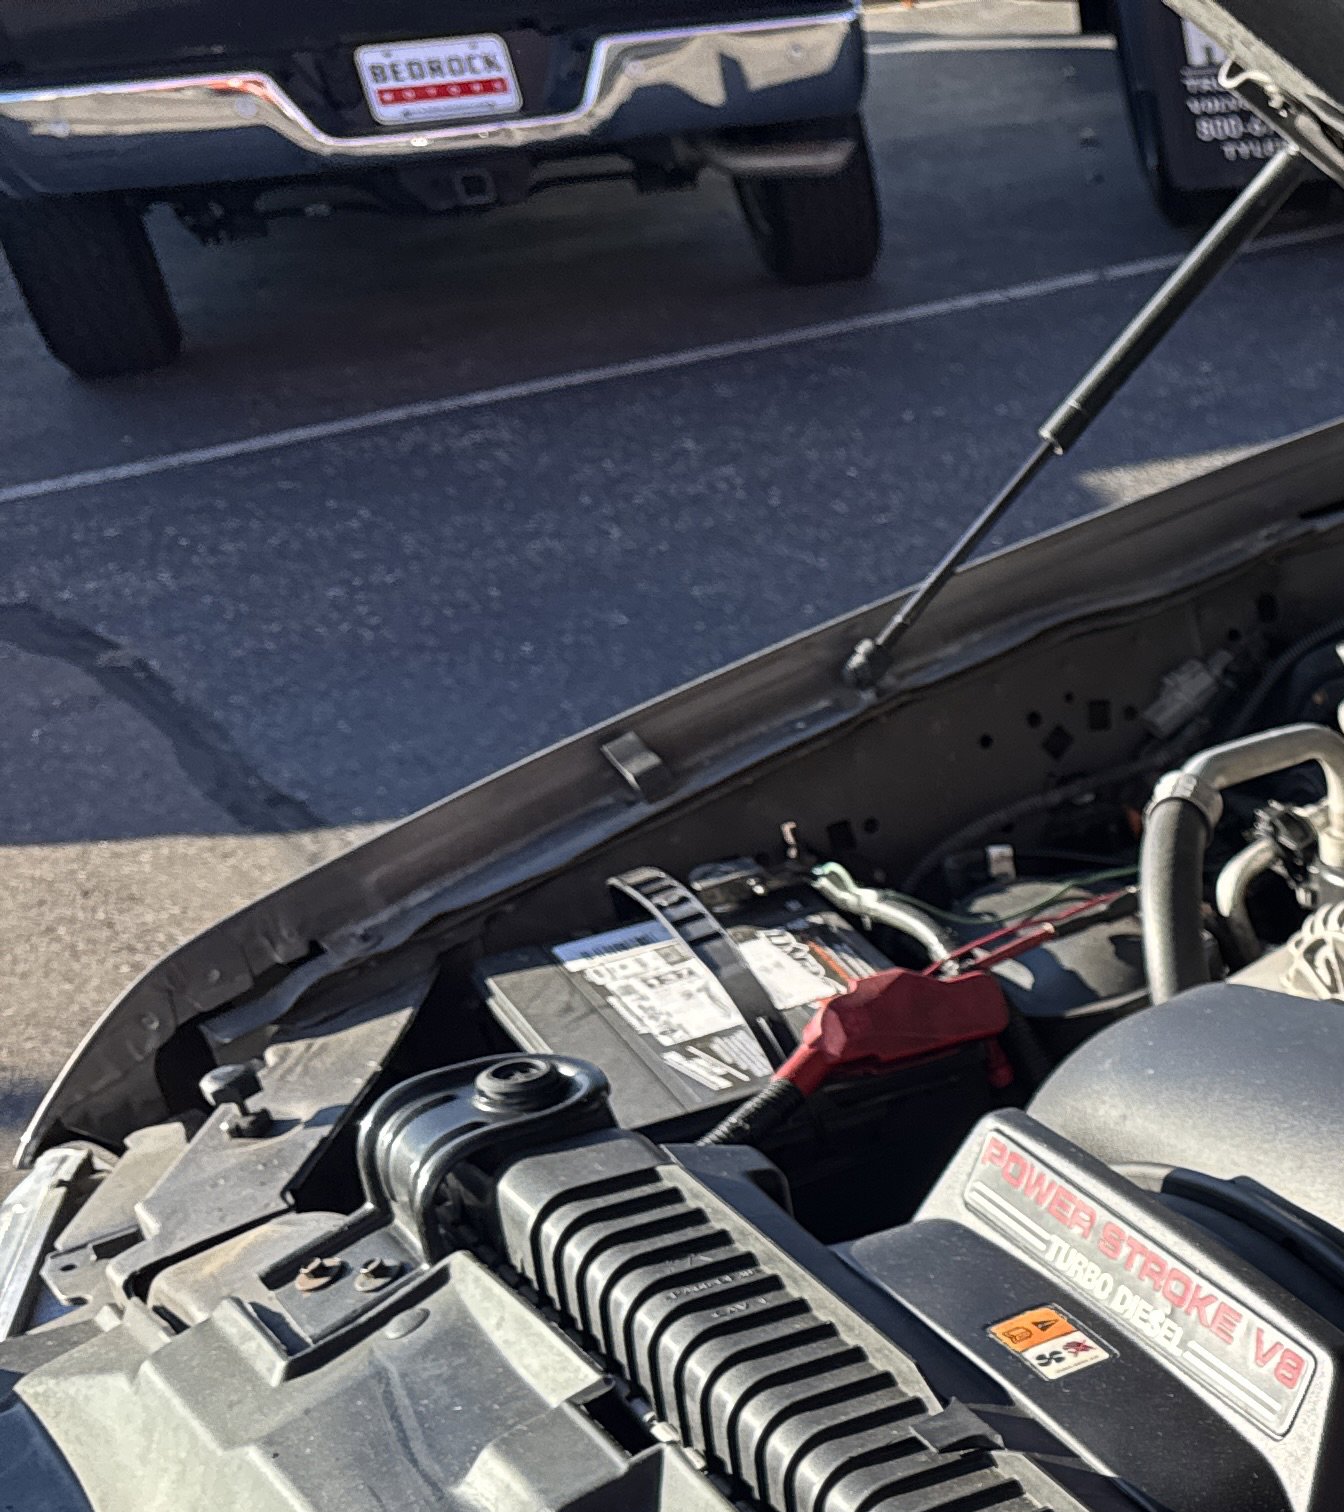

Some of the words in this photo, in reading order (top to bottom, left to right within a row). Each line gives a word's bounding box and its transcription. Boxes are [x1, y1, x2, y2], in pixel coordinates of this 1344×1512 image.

[369, 53, 502, 84] BEDROCK
[980, 1137, 1097, 1239] POWER
[1098, 1222, 1244, 1345] STROKE
[1253, 1328, 1306, 1390] V8
[1044, 1232, 1116, 1302] TURBO
[1110, 1287, 1185, 1357] DIESEL
